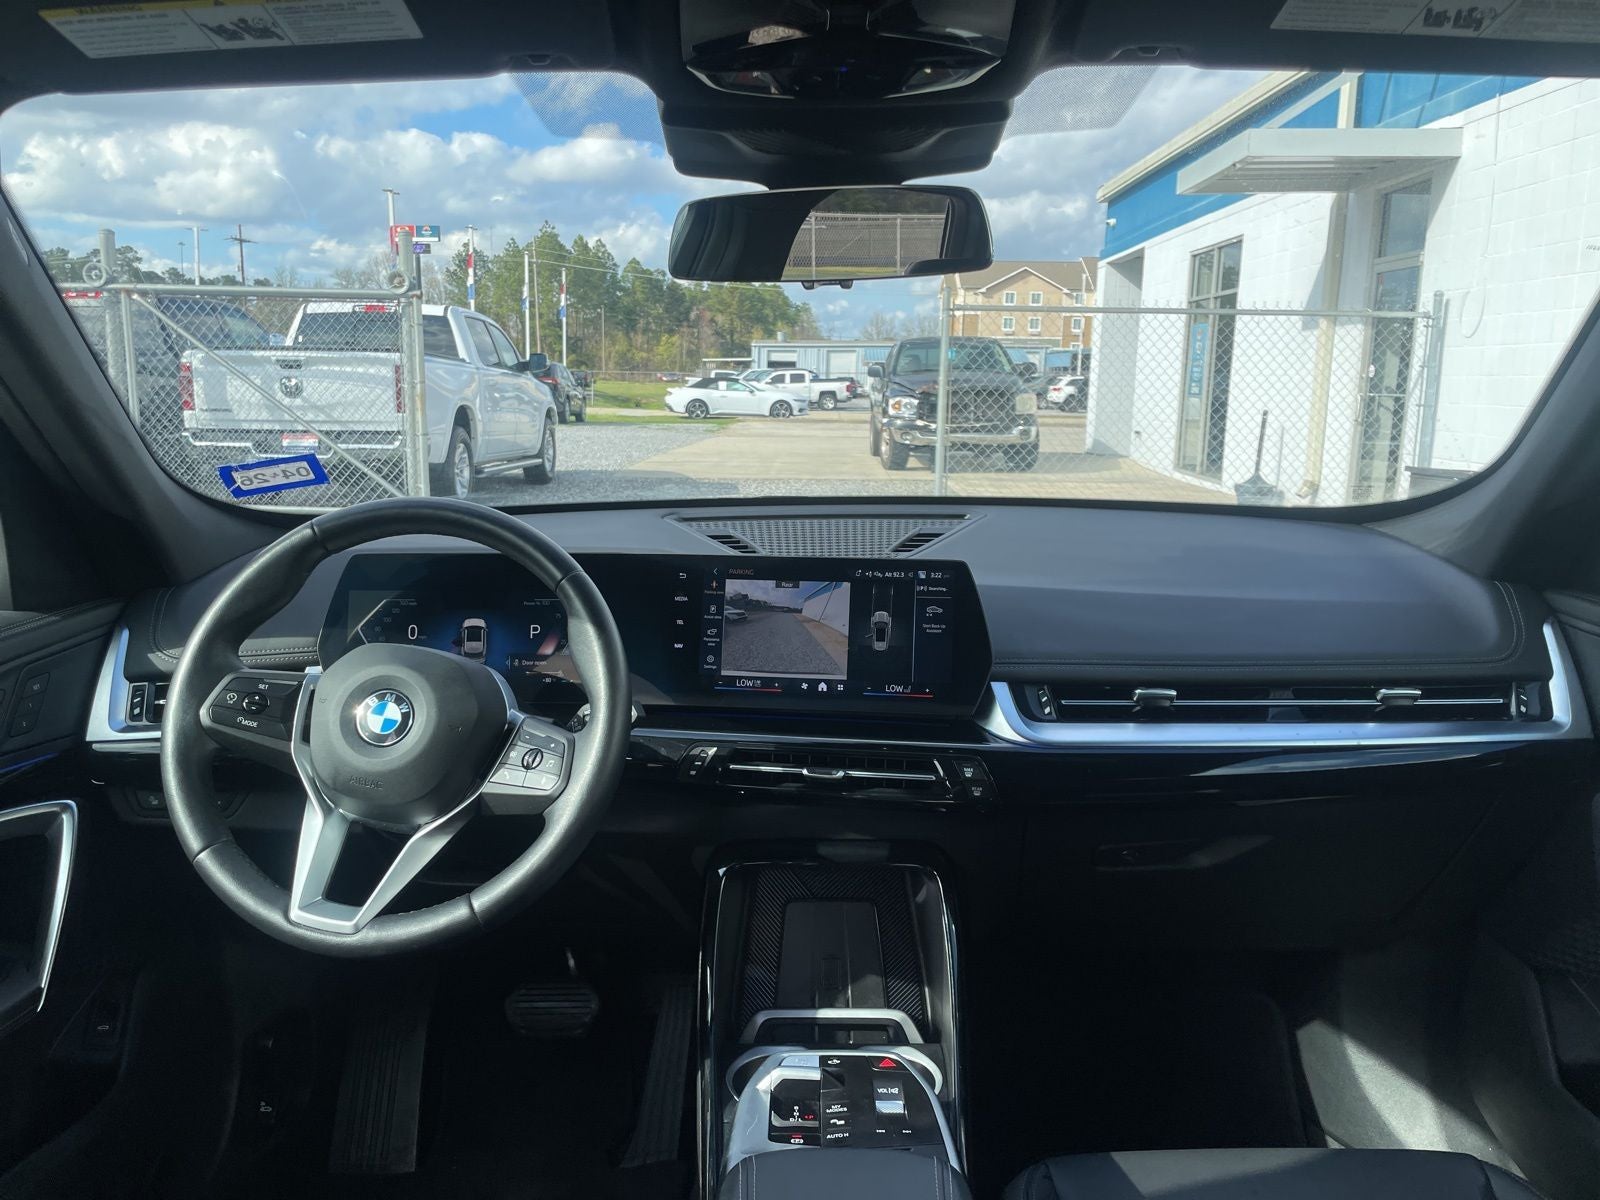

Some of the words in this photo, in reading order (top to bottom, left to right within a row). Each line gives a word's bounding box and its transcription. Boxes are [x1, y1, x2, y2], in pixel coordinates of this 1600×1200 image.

[728, 568, 754, 576] PARKING
[408, 624, 418, 640] 0
[530, 624, 541, 639] P
[736, 679, 754, 687] LOW
[885, 684, 904, 692] LOW
[367, 693, 410, 713] BMW
[241, 720, 259, 728] MODE
[349, 775, 384, 789] AIRBAG
